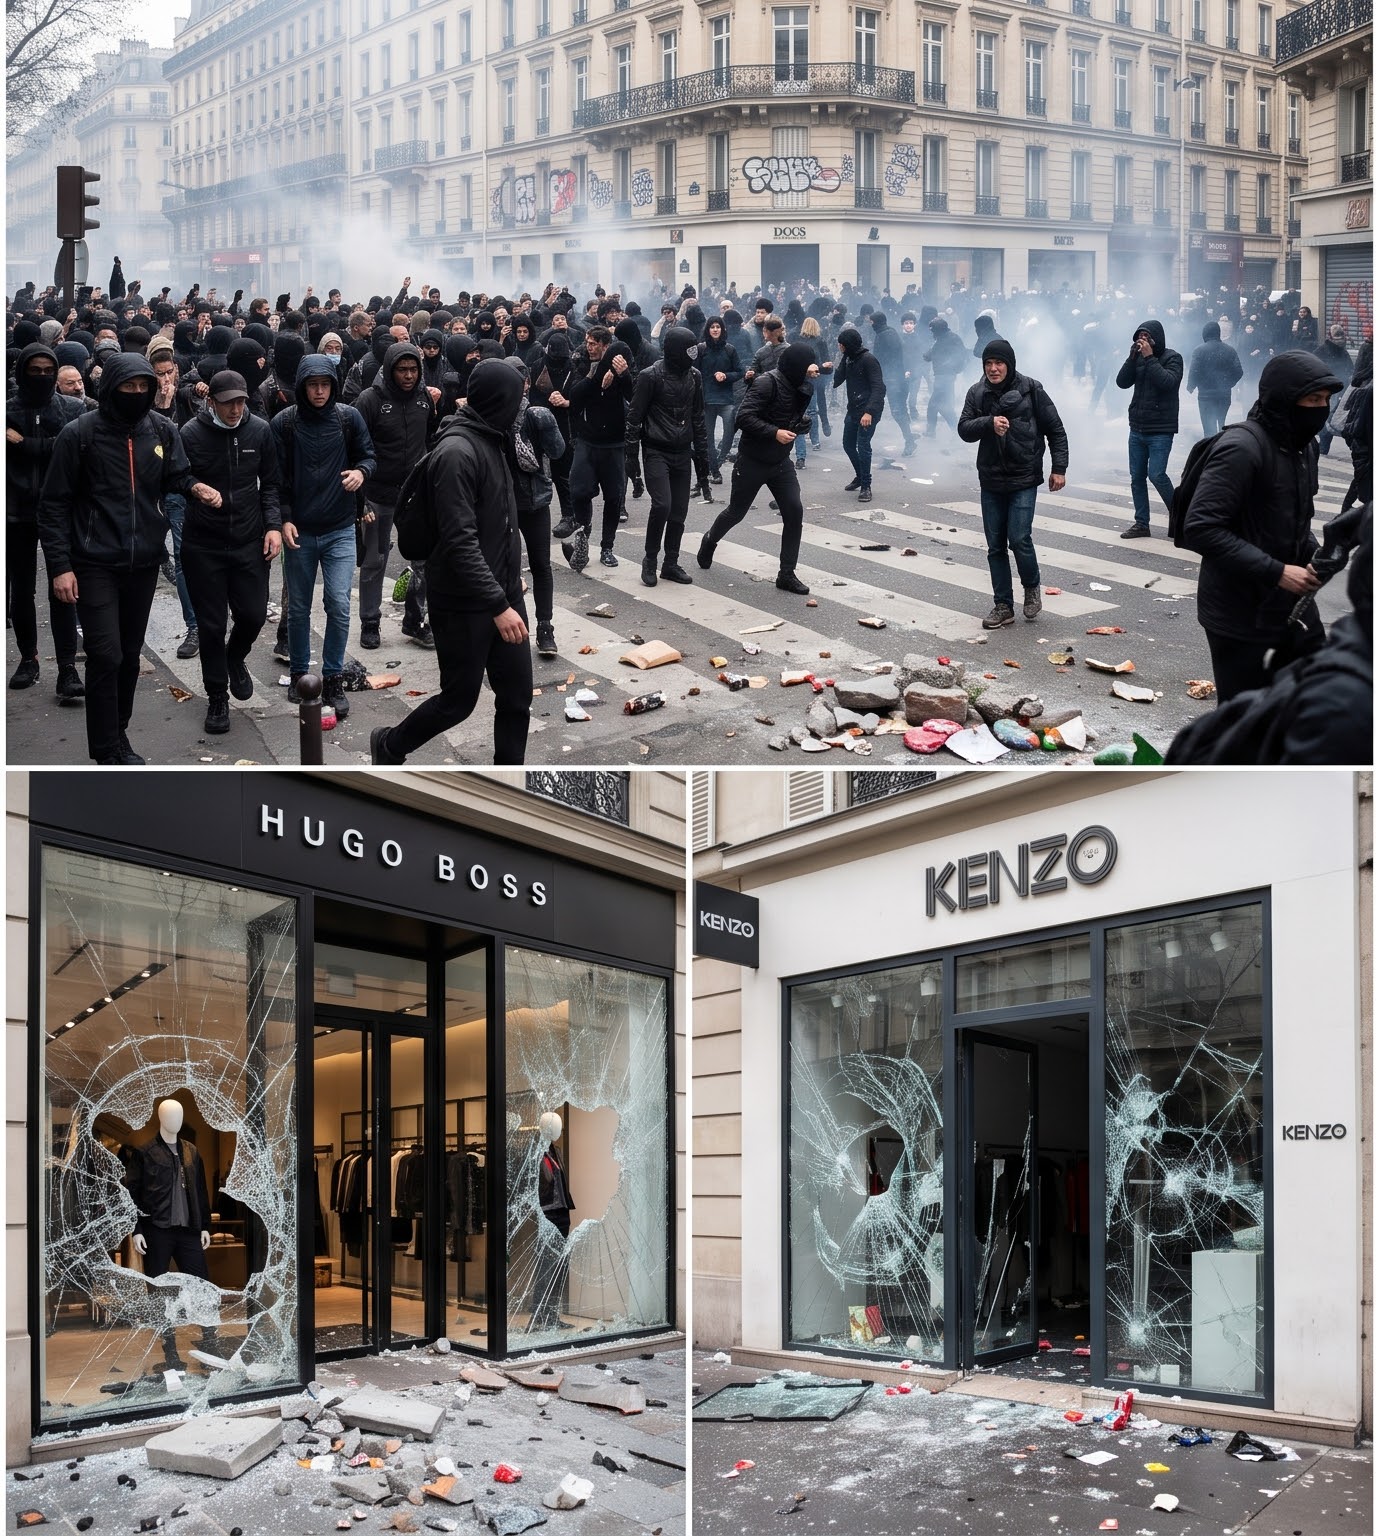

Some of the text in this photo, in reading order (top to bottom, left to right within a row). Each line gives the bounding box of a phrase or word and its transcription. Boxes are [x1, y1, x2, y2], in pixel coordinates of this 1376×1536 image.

[773, 226, 806, 237] DOCS
[261, 803, 547, 906] HUGO BOSS
[925, 824, 1119, 918] KENZO
[700, 910, 755, 938] KENZO
[1282, 1123, 1347, 1141] KENZO
